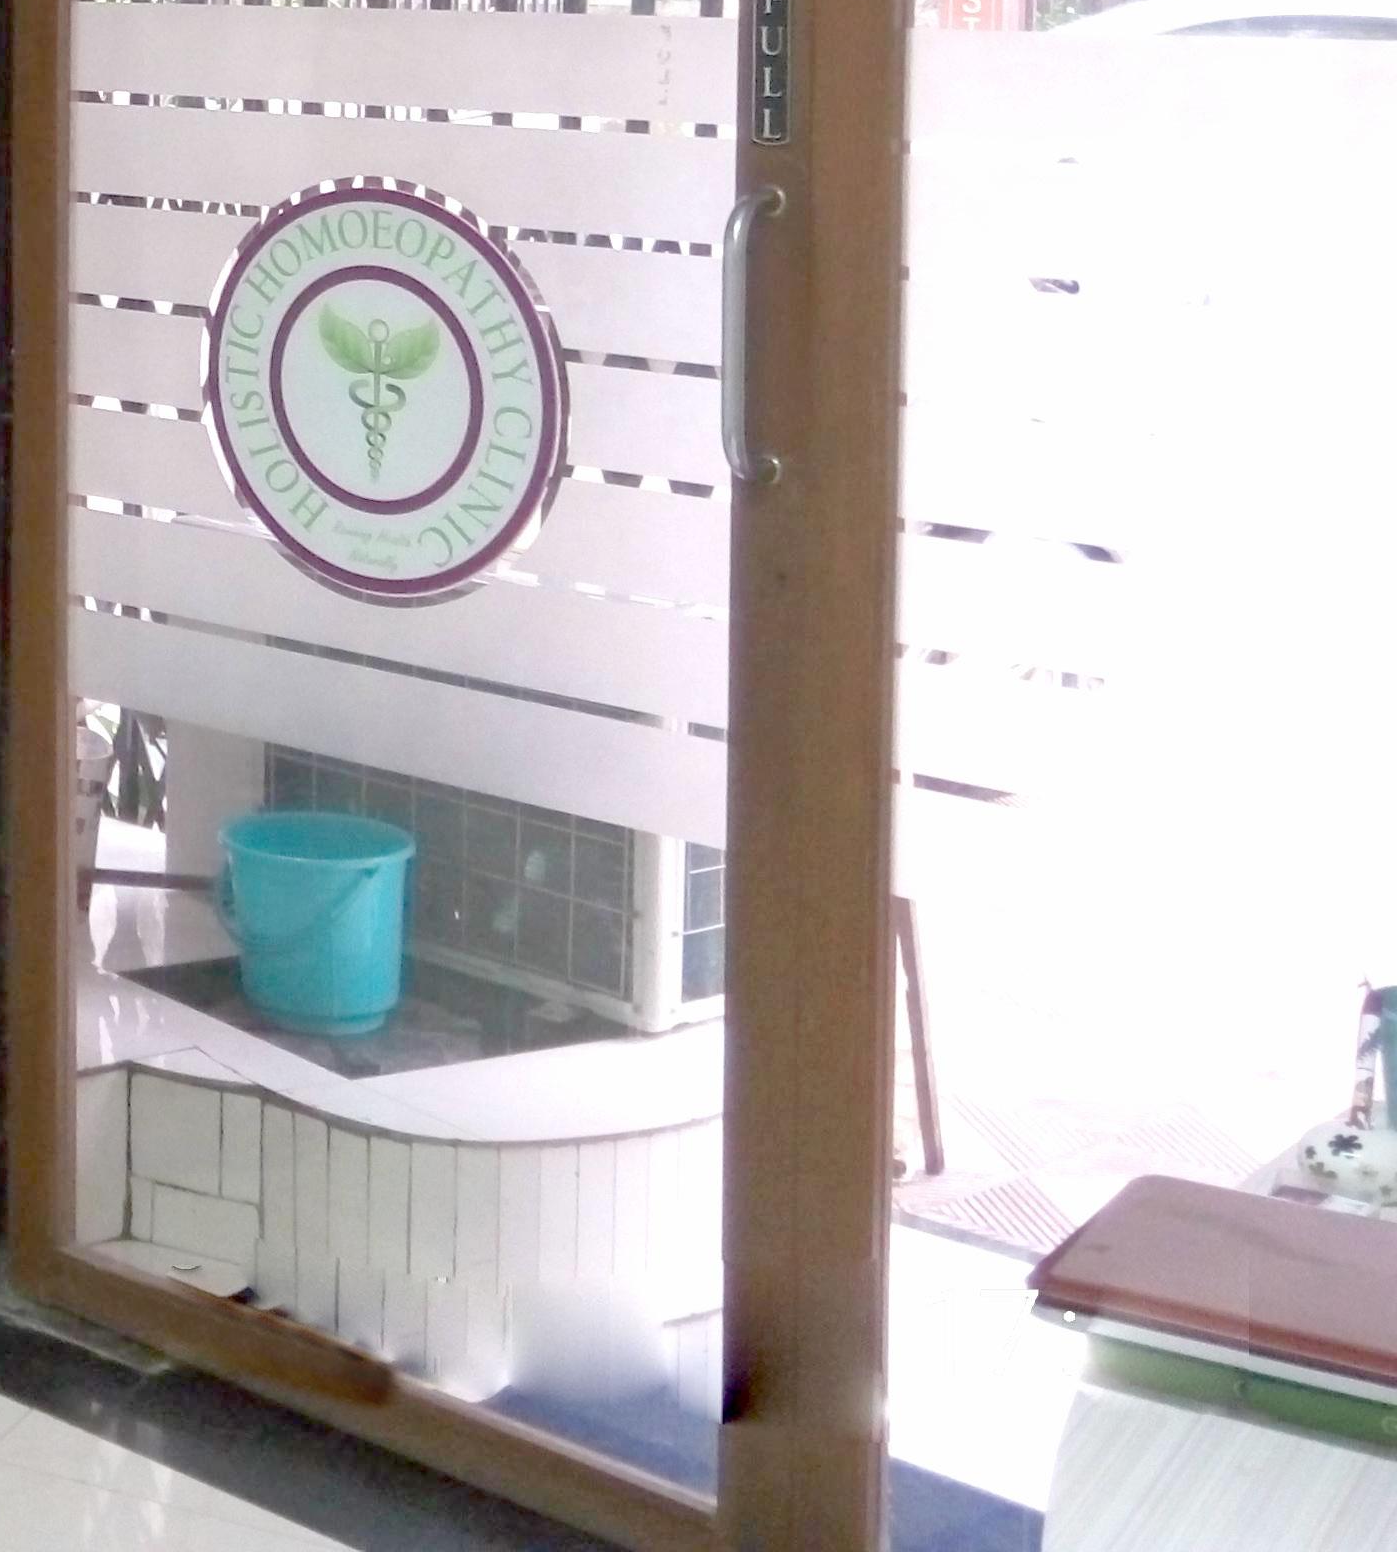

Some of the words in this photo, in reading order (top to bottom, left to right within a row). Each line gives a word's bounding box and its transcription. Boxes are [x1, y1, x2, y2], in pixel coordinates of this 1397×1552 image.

[243, 207, 535, 388] HOMOEOPATHY
[223, 302, 330, 530] HOLISTIC
[416, 404, 534, 568] CLINIC
